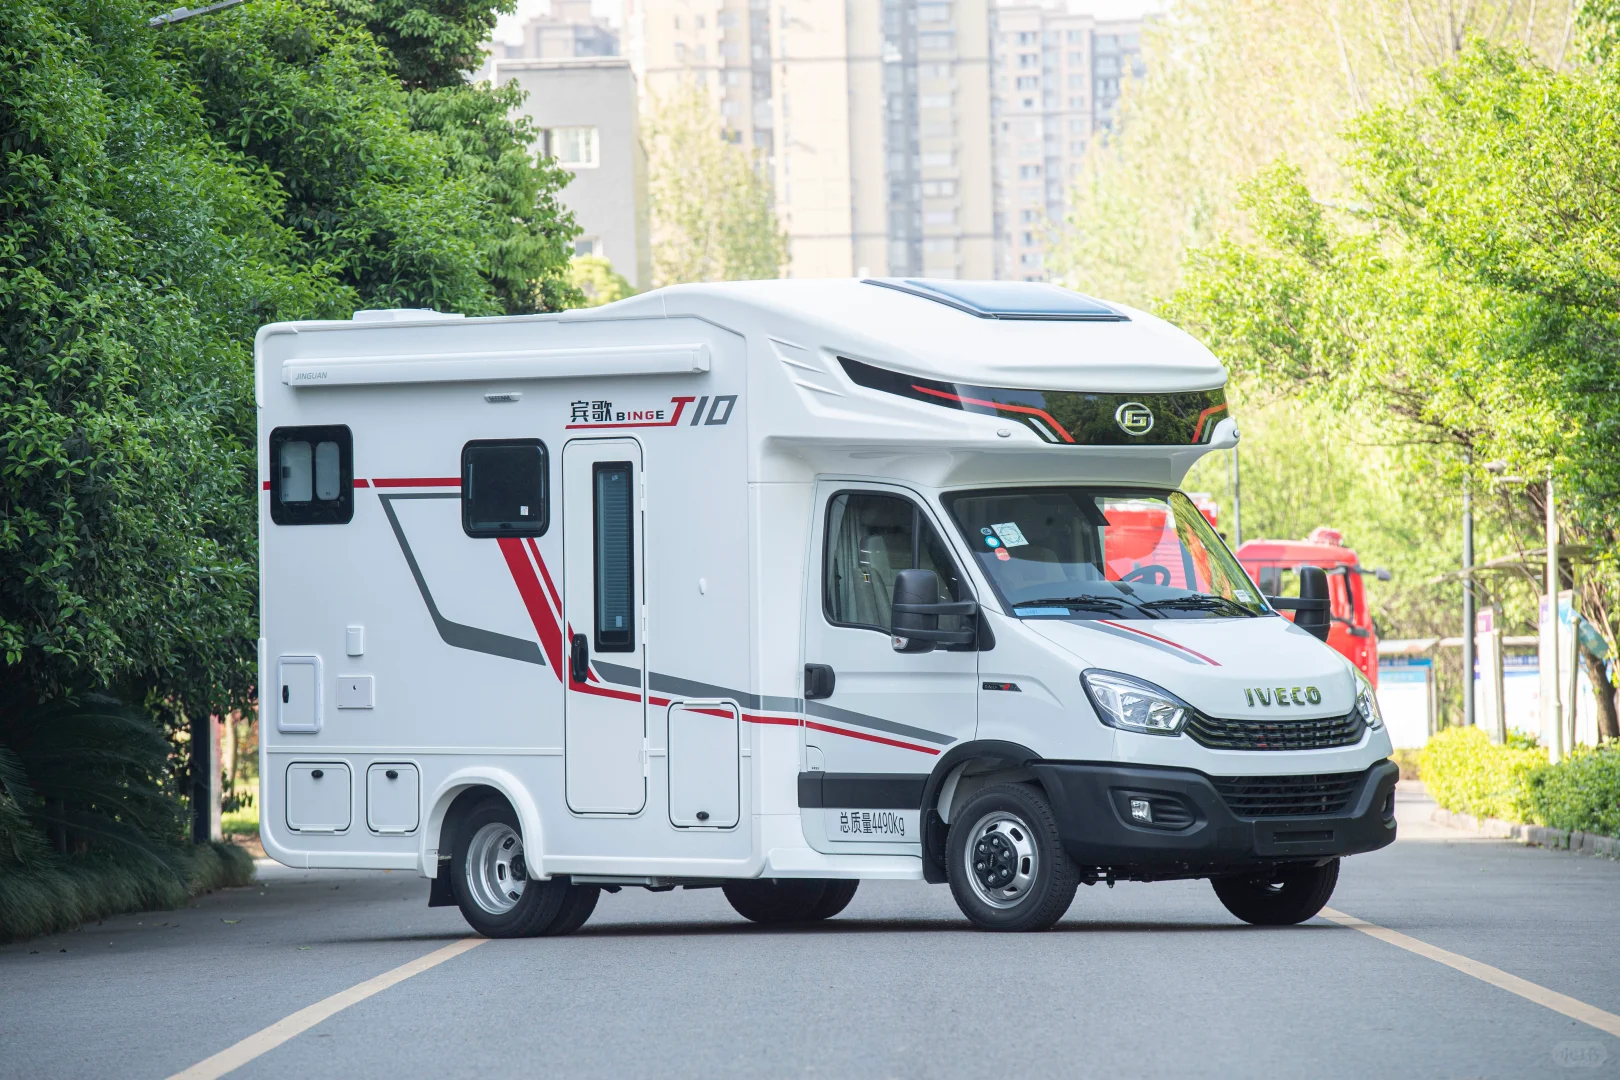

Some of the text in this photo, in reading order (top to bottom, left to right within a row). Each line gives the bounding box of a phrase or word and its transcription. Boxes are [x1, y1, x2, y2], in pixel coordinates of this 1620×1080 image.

[295, 371, 328, 381] JINGUAN
[570, 394, 738, 427] 宾歌 BINGE T10
[1243, 685, 1322, 707] IVECO
[840, 811, 905, 837] 总质量4490kg
